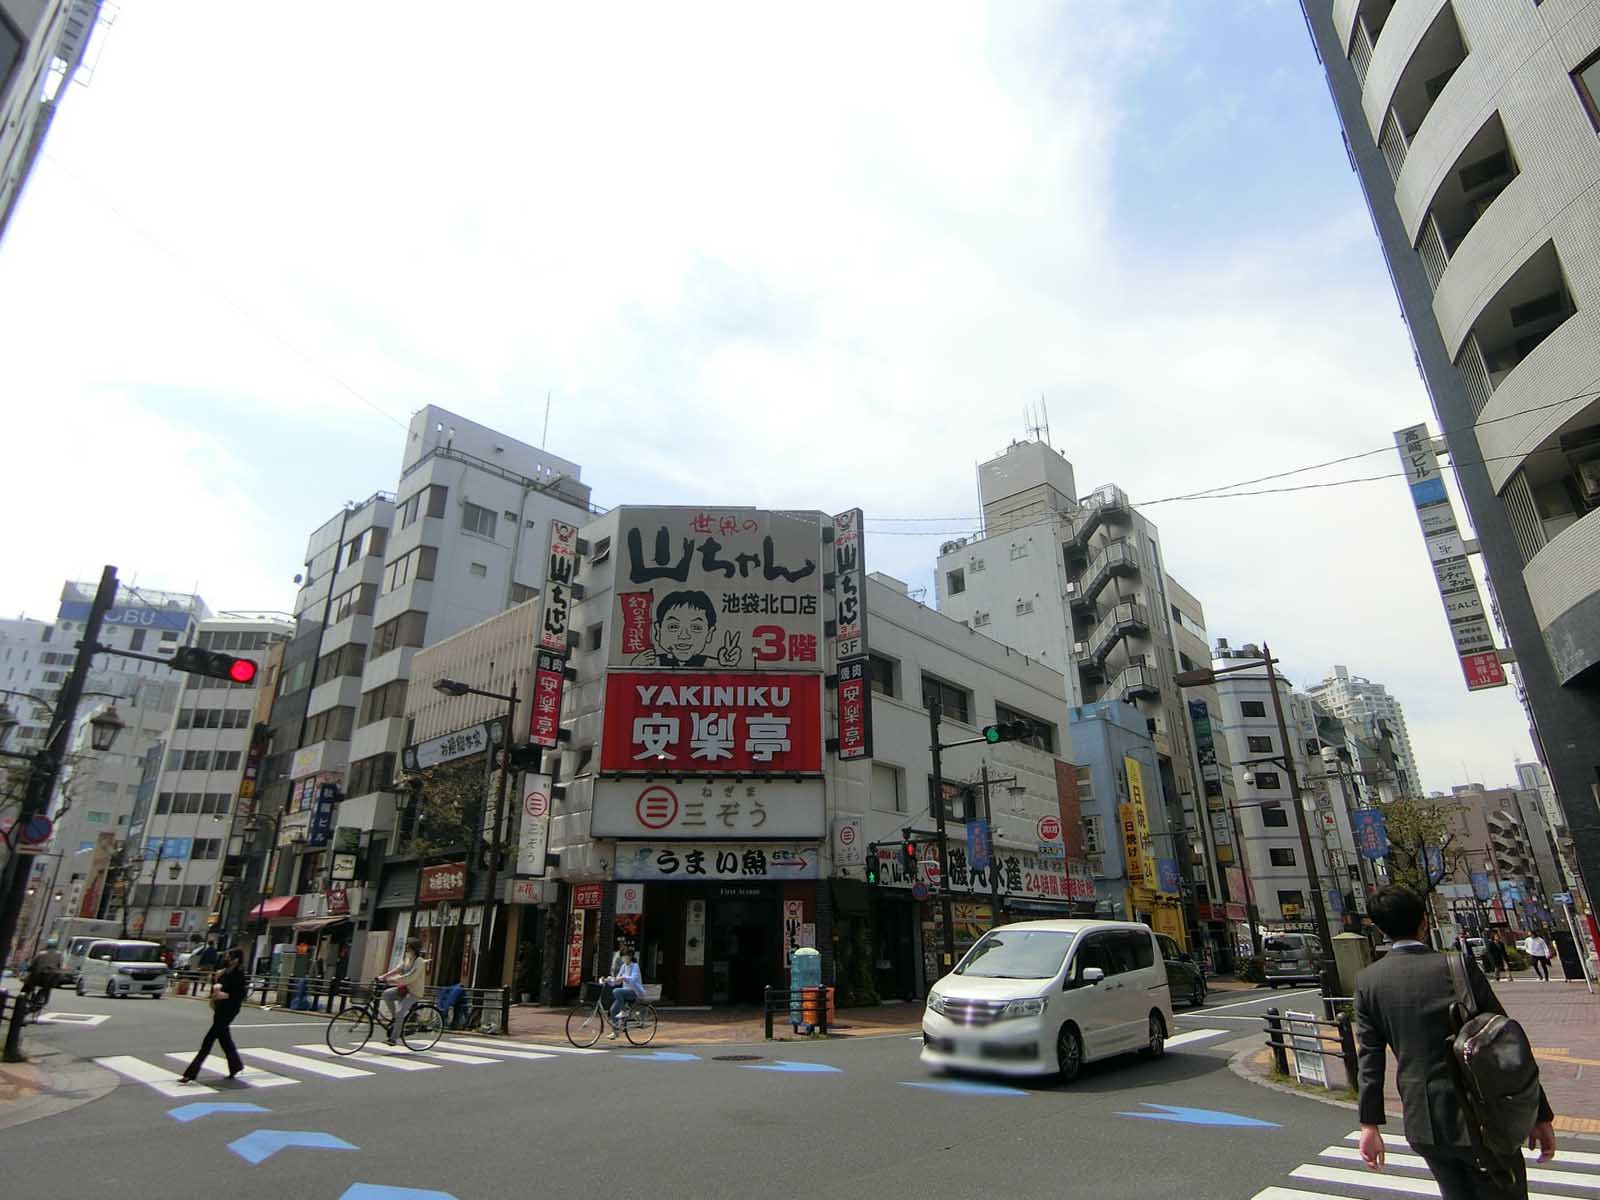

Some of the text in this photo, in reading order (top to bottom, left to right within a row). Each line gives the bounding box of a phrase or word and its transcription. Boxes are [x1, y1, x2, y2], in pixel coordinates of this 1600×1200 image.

[689, 512, 758, 536] 世界の
[627, 525, 815, 584] 山ちゃん
[544, 554, 572, 635] 山ちゃん
[837, 544, 858, 626] 山ちゃん
[721, 592, 818, 616] 池袋北口店
[1457, 599, 1480, 610] ALC
[752, 624, 817, 662] 3階
[841, 640, 858, 655] 3F
[840, 664, 862, 680] 焼肉
[537, 676, 558, 735] 安楽亭
[635, 685, 791, 707] YAKINIKU
[843, 686, 860, 745] 安楽亭
[633, 713, 792, 761] 安楽亭
[702, 785, 757, 798] ねぎま
[682, 802, 767, 827] 三ぞう
[1125, 821, 1137, 857] 日焼け
[656, 849, 768, 876] うまい魚
